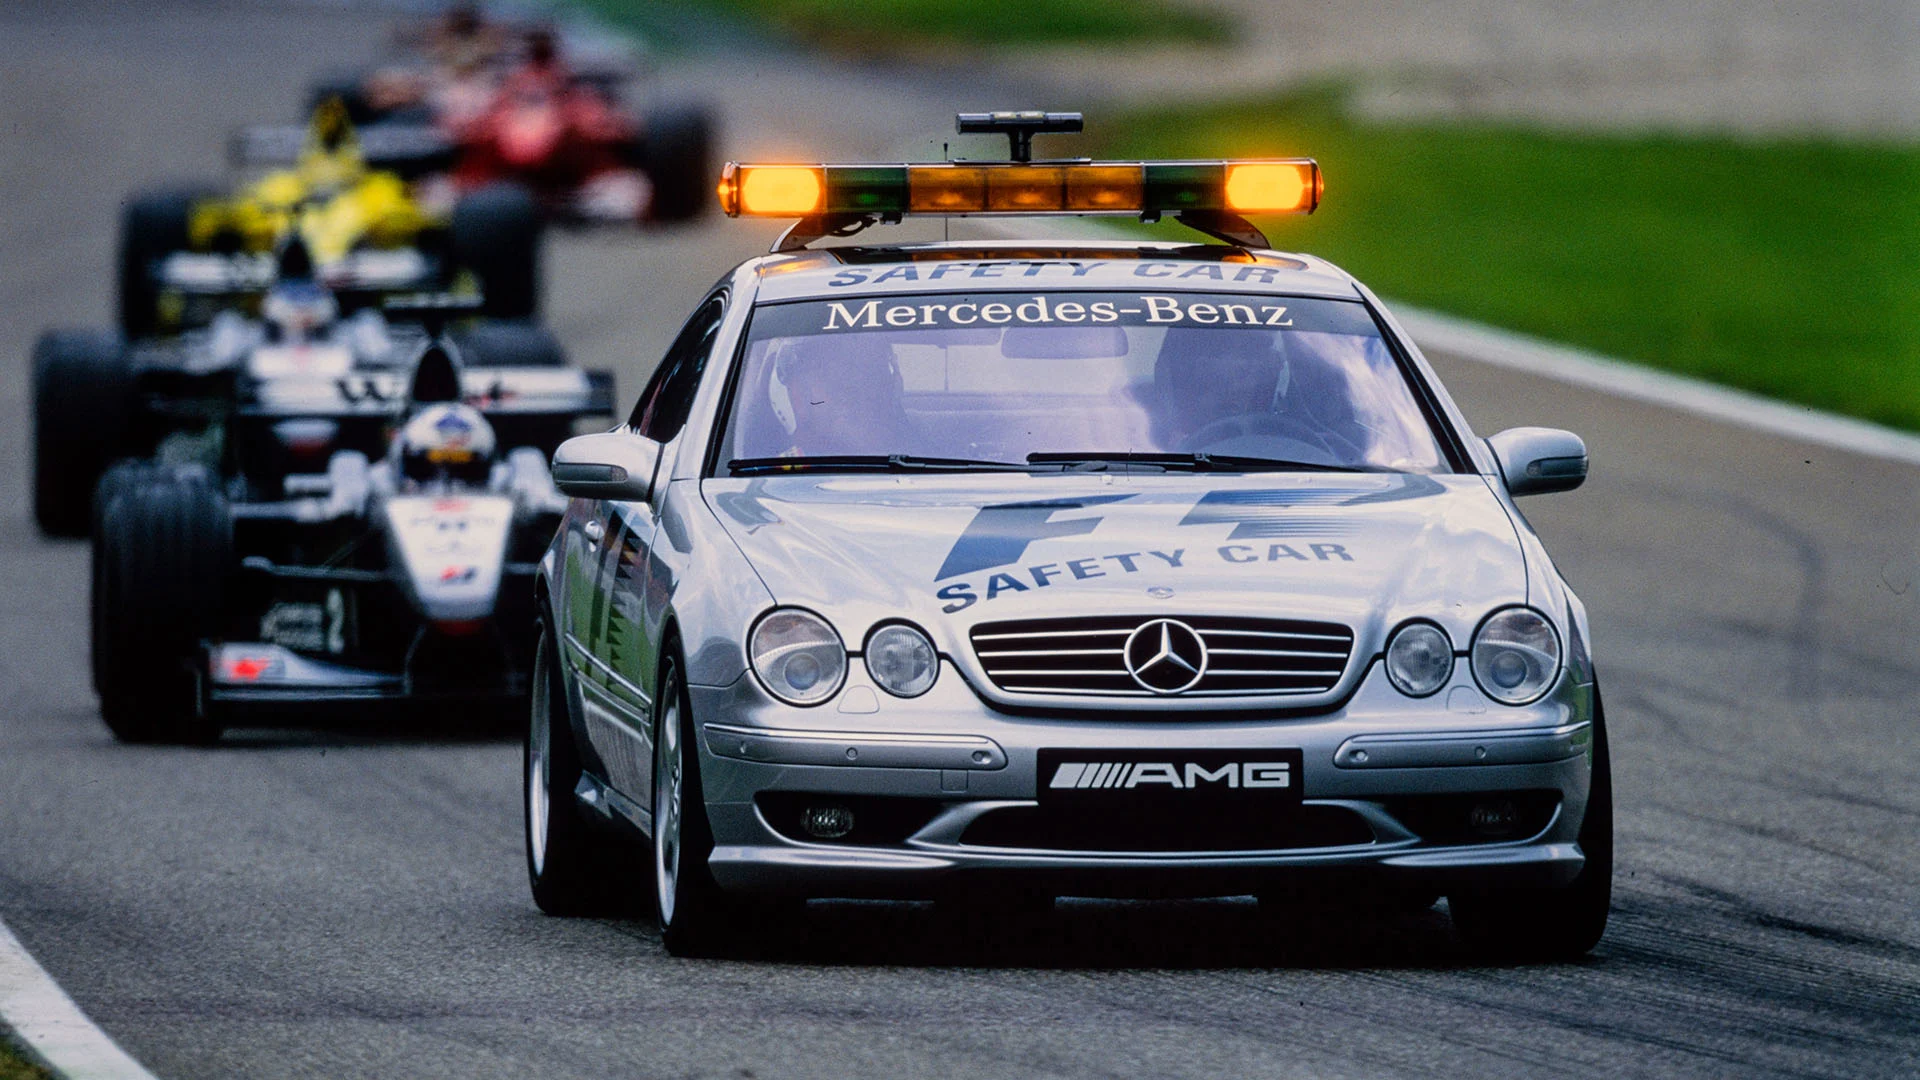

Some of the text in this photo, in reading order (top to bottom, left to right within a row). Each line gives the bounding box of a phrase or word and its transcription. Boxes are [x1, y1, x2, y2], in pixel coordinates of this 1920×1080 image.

[828, 259, 1280, 288] SAFETY CAR
[822, 295, 1293, 330] Mercedes-Benz
[936, 543, 1356, 613] SAFETY CAR
[1124, 763, 1290, 788] AMG
